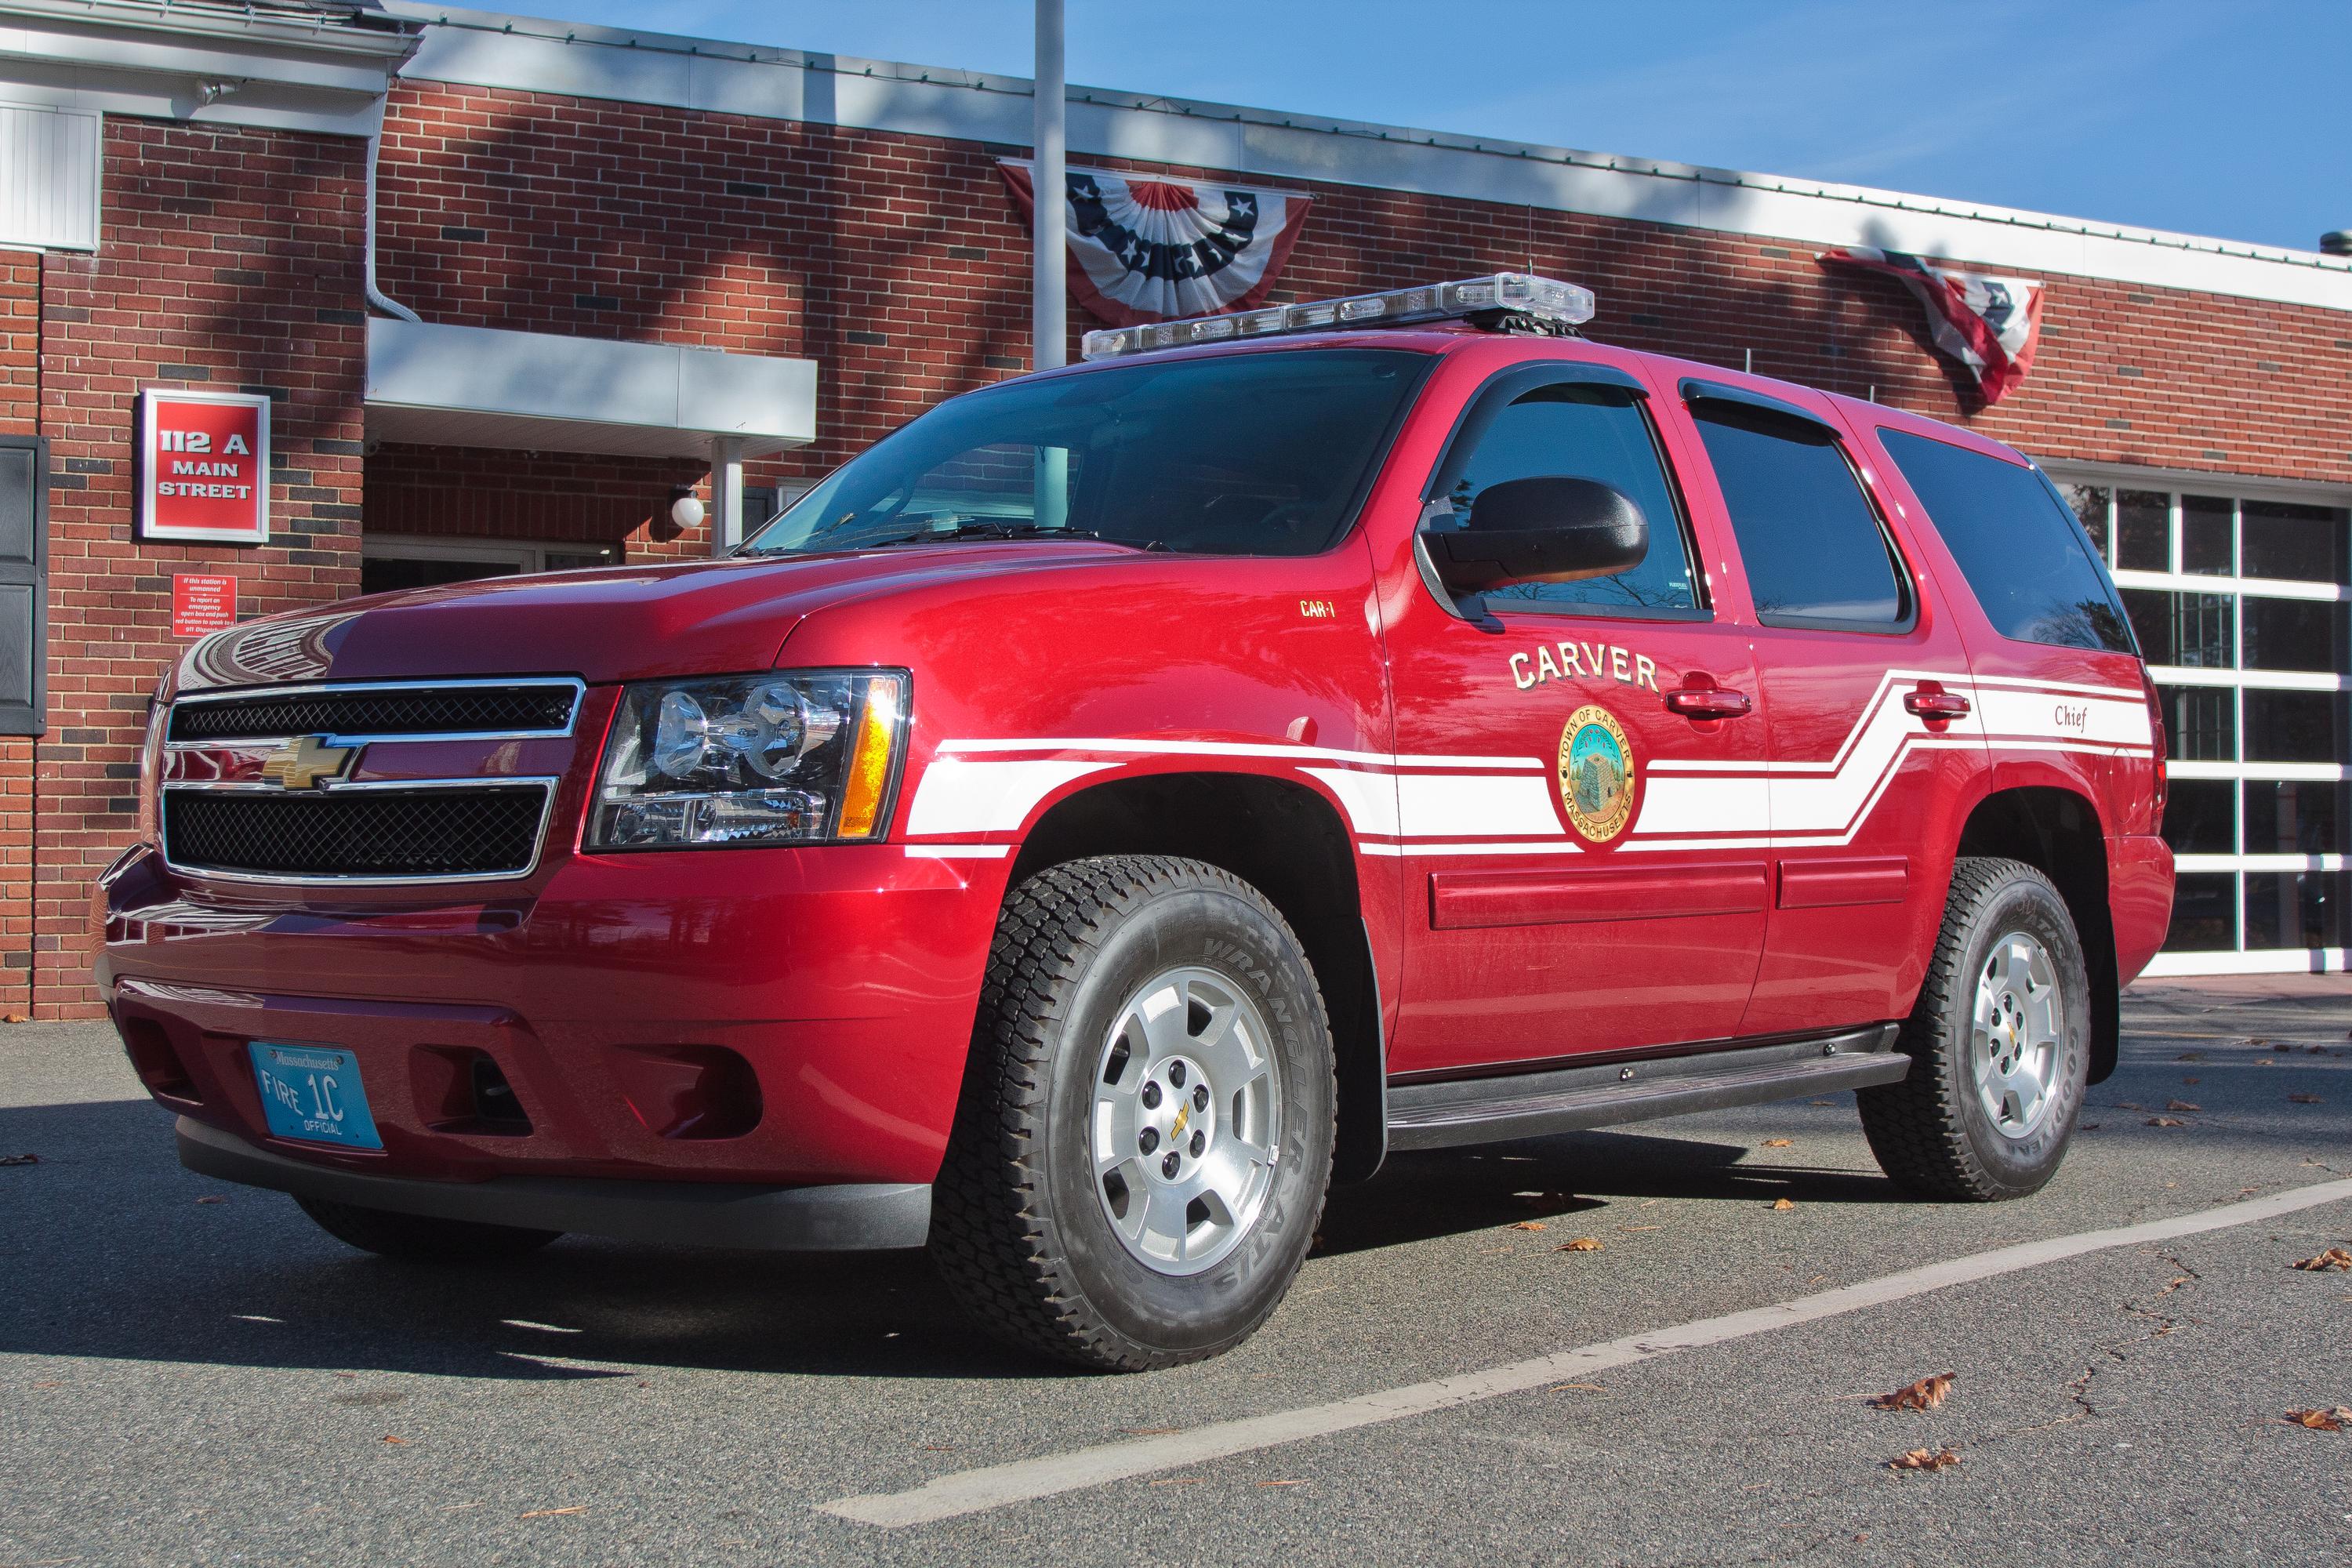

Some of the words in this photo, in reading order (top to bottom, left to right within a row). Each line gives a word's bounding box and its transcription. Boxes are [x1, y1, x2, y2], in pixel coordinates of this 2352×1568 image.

[160, 430, 211, 453] 112
[223, 434, 249, 455] A
[172, 461, 238, 477] MAIN
[158, 482, 252, 499] STREET
[1508, 641, 1660, 693] CARVER
[2055, 706, 2087, 733] Chief
[1561, 719, 1577, 759] TOWN
[1579, 710, 1591, 721] OF
[1595, 710, 1630, 759] CARVER
[1565, 792, 1632, 837] MASSACHUSETTS
[276, 1051, 339, 1070] Massachusetts
[1202, 938, 1308, 1177] WRANGLER
[261, 1069, 303, 1116] FIRE
[308, 1074, 343, 1121] 1C
[304, 1120, 342, 1134] OFFICIAL
